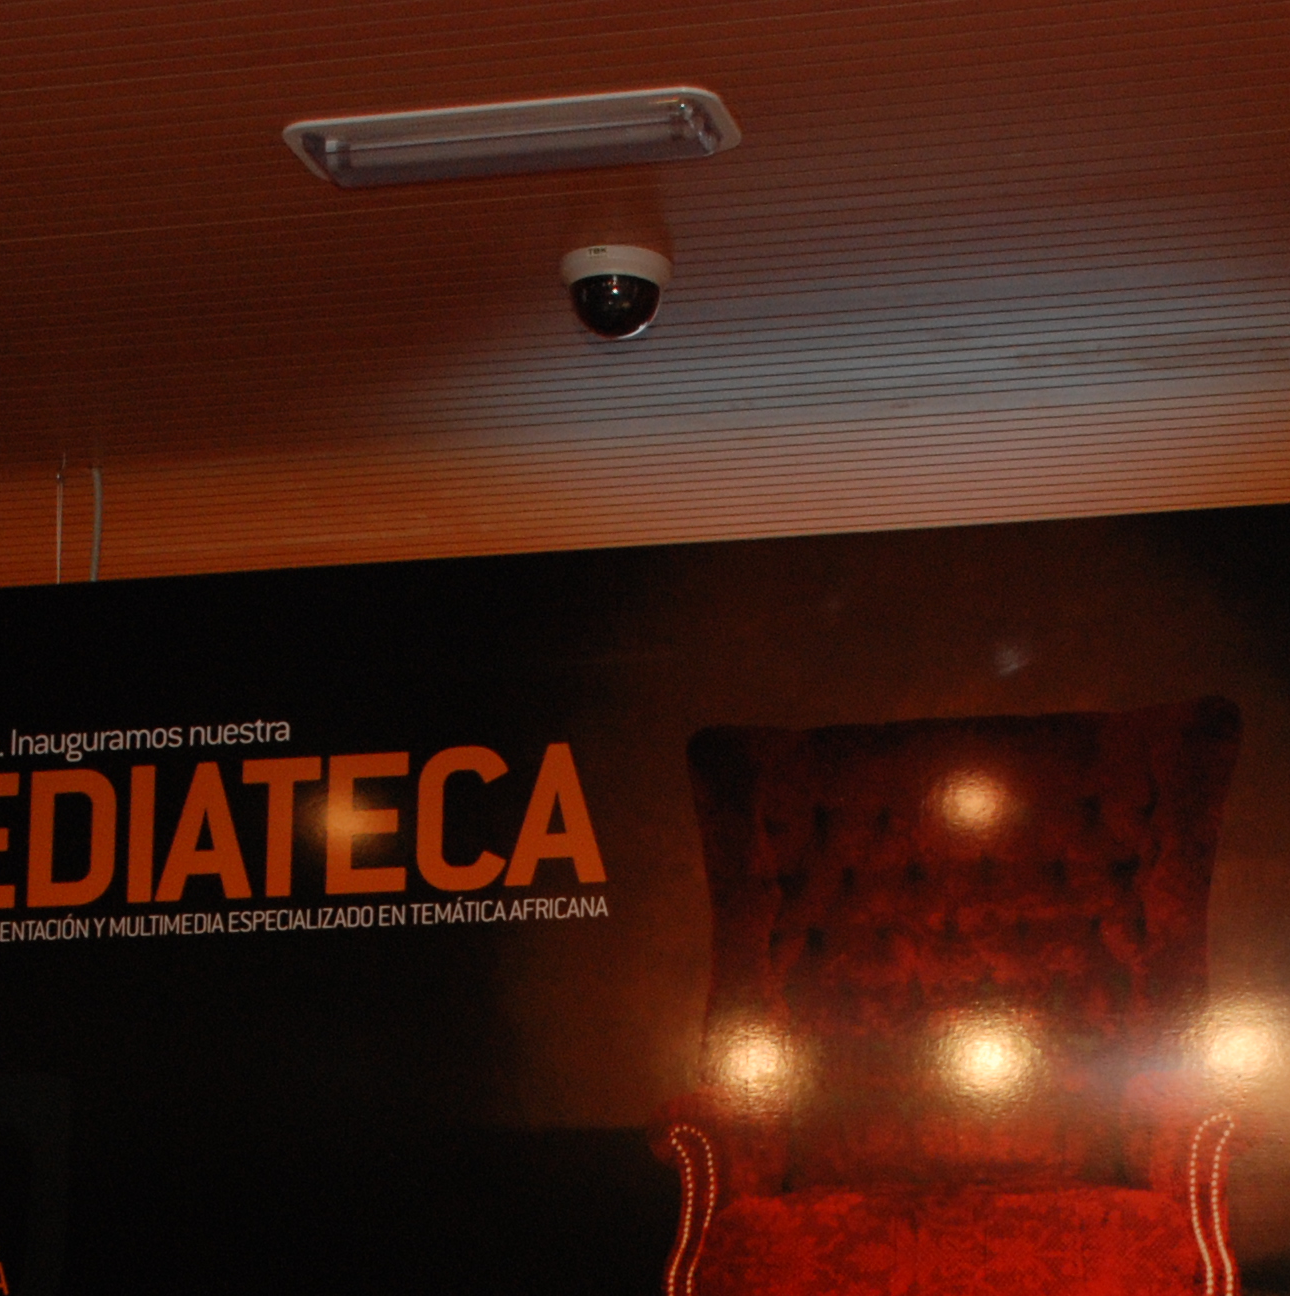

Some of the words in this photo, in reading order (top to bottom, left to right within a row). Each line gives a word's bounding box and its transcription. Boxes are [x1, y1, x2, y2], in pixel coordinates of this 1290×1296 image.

[11, 729, 183, 762] Inauguramos
[189, 719, 291, 746] nuestra
[93, 917, 106, 939] Y
[110, 912, 224, 938] MULTIMEDIA
[227, 905, 374, 933] ESPECIALIZADO
[378, 904, 406, 927] EN
[410, 896, 507, 925] TEMÁTICA
[509, 896, 609, 921] AFRICANA
